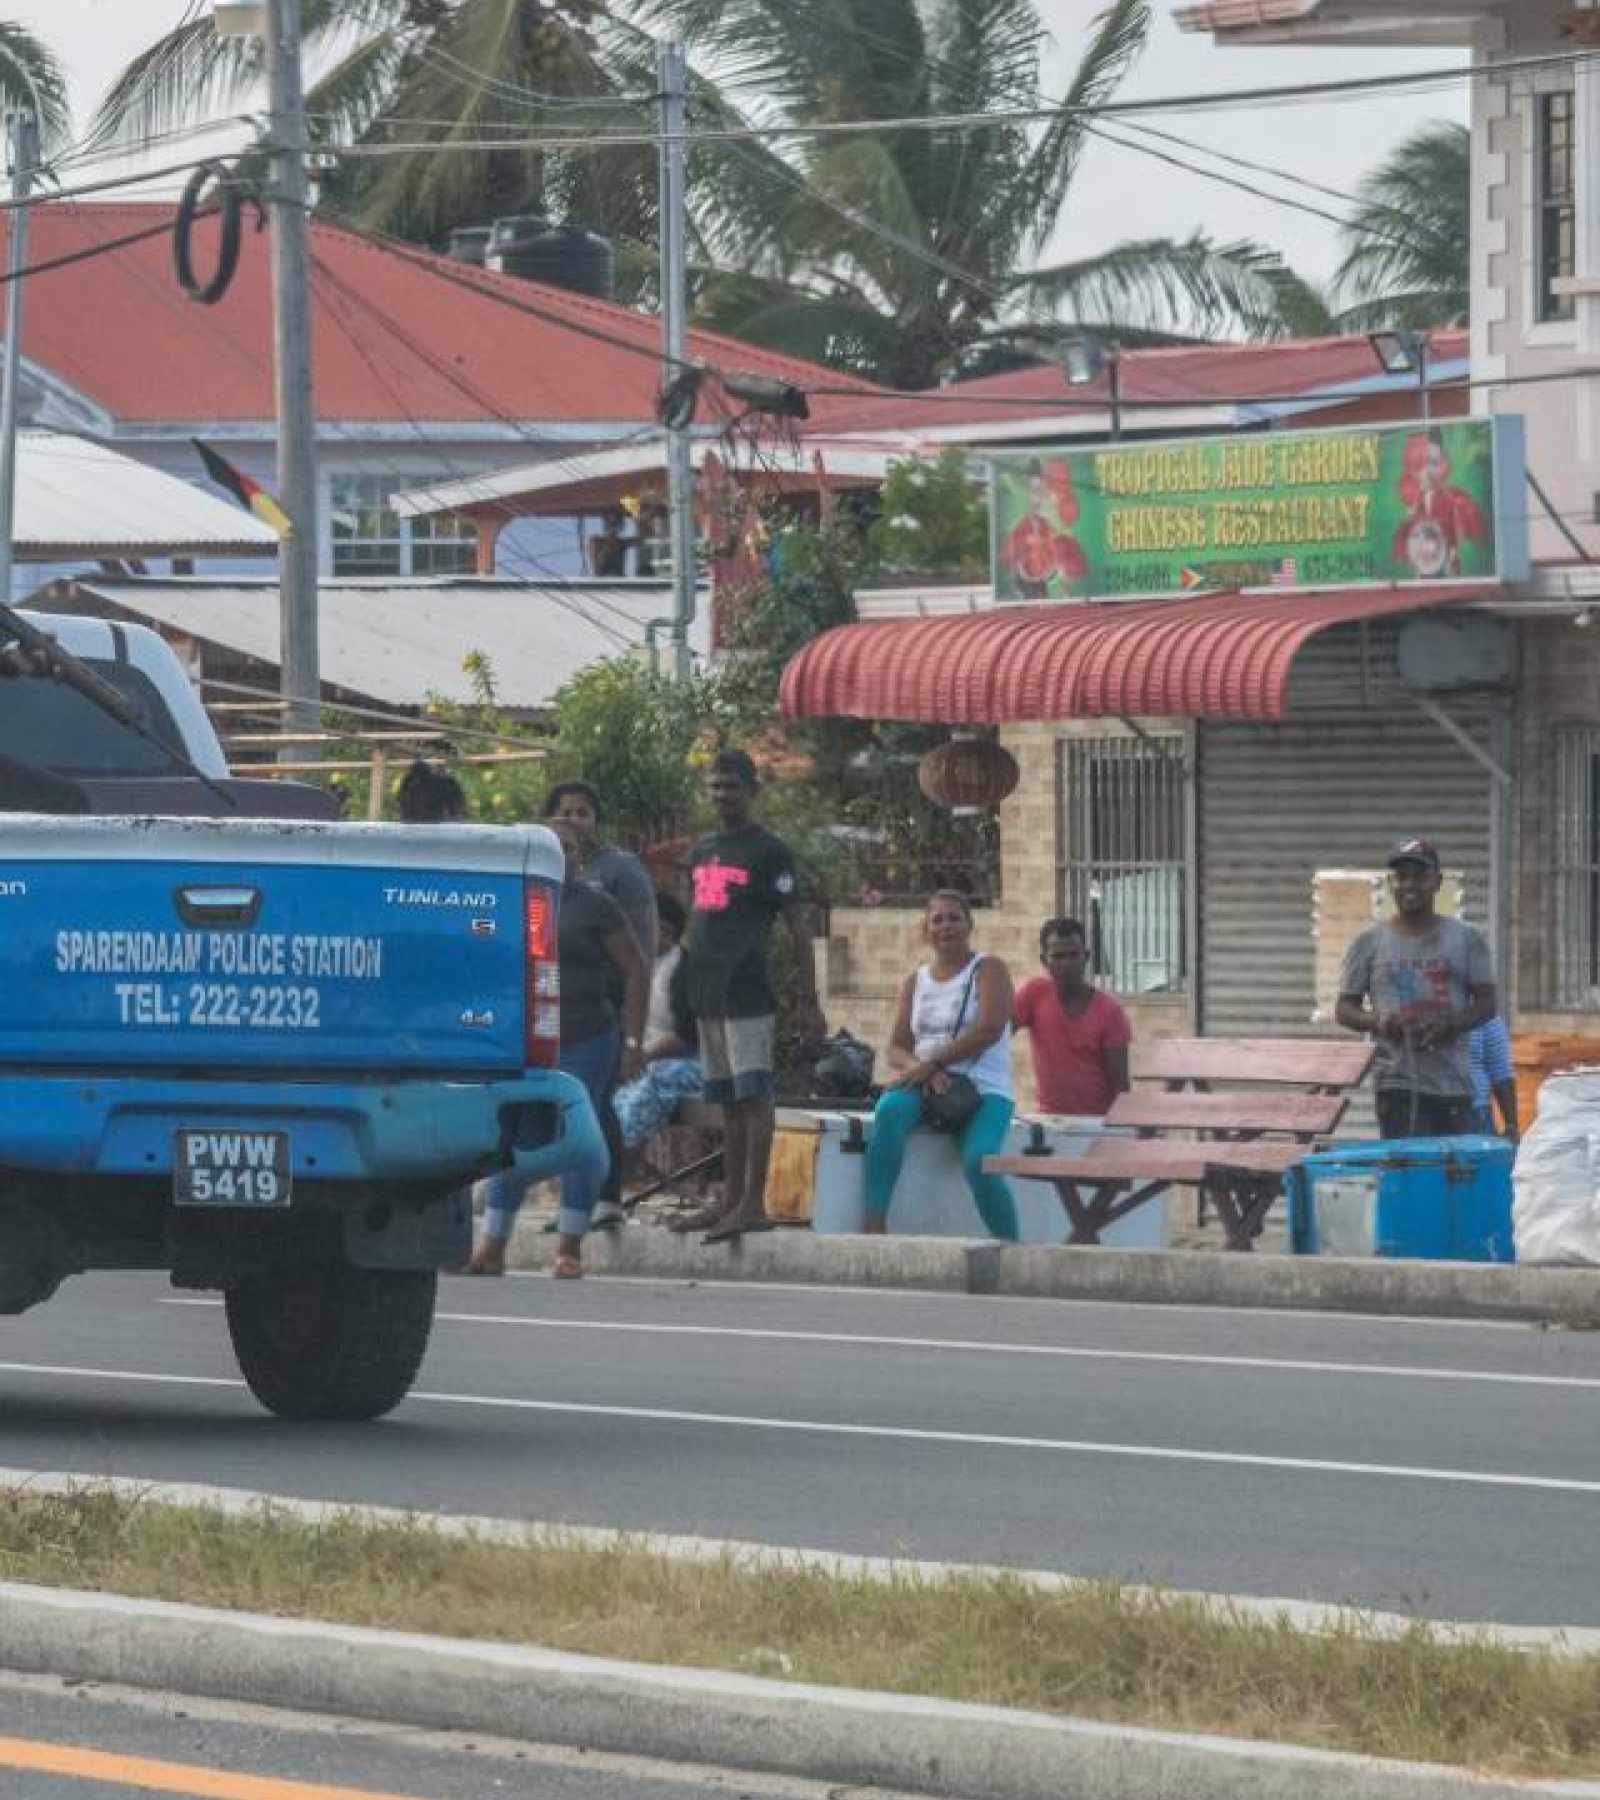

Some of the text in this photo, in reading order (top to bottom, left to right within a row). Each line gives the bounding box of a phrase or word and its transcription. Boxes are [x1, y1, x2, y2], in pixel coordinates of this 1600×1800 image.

[1095, 448, 1208, 495] TROPICAL
[1278, 432, 1379, 484] GARDEN
[1108, 494, 1369, 551] CHINESE RESTAURANT
[383, 888, 496, 906] TUNLAND
[56, 930, 382, 978] SPARENDAAM POLICE STATION
[114, 983, 321, 1028] TEL: 222-2232
[186, 1135, 277, 1167] PWW
[191, 1168, 276, 1200] 5419
